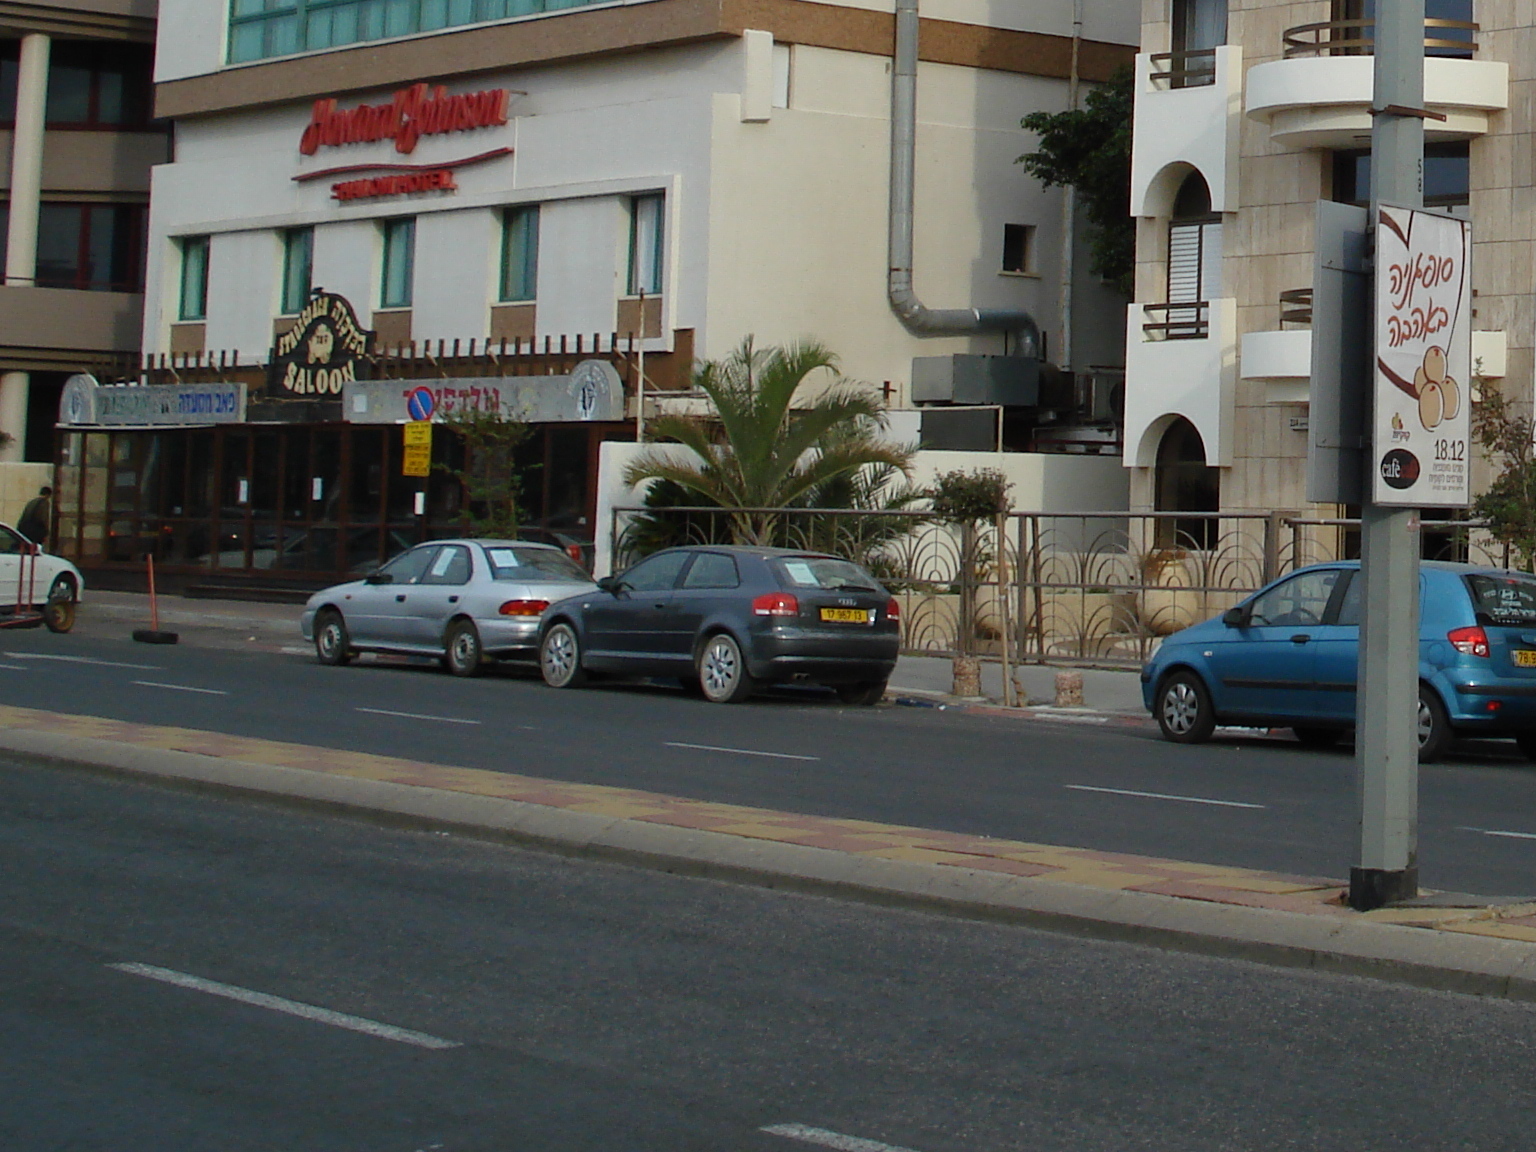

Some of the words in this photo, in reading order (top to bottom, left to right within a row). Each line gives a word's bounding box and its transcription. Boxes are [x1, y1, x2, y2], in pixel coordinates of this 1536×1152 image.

[1389, 252, 1454, 311] סופגניה
[1388, 297, 1449, 348] באהבה
[284, 359, 356, 395] SALOON
[1434, 439, 1465, 461] 18.12
